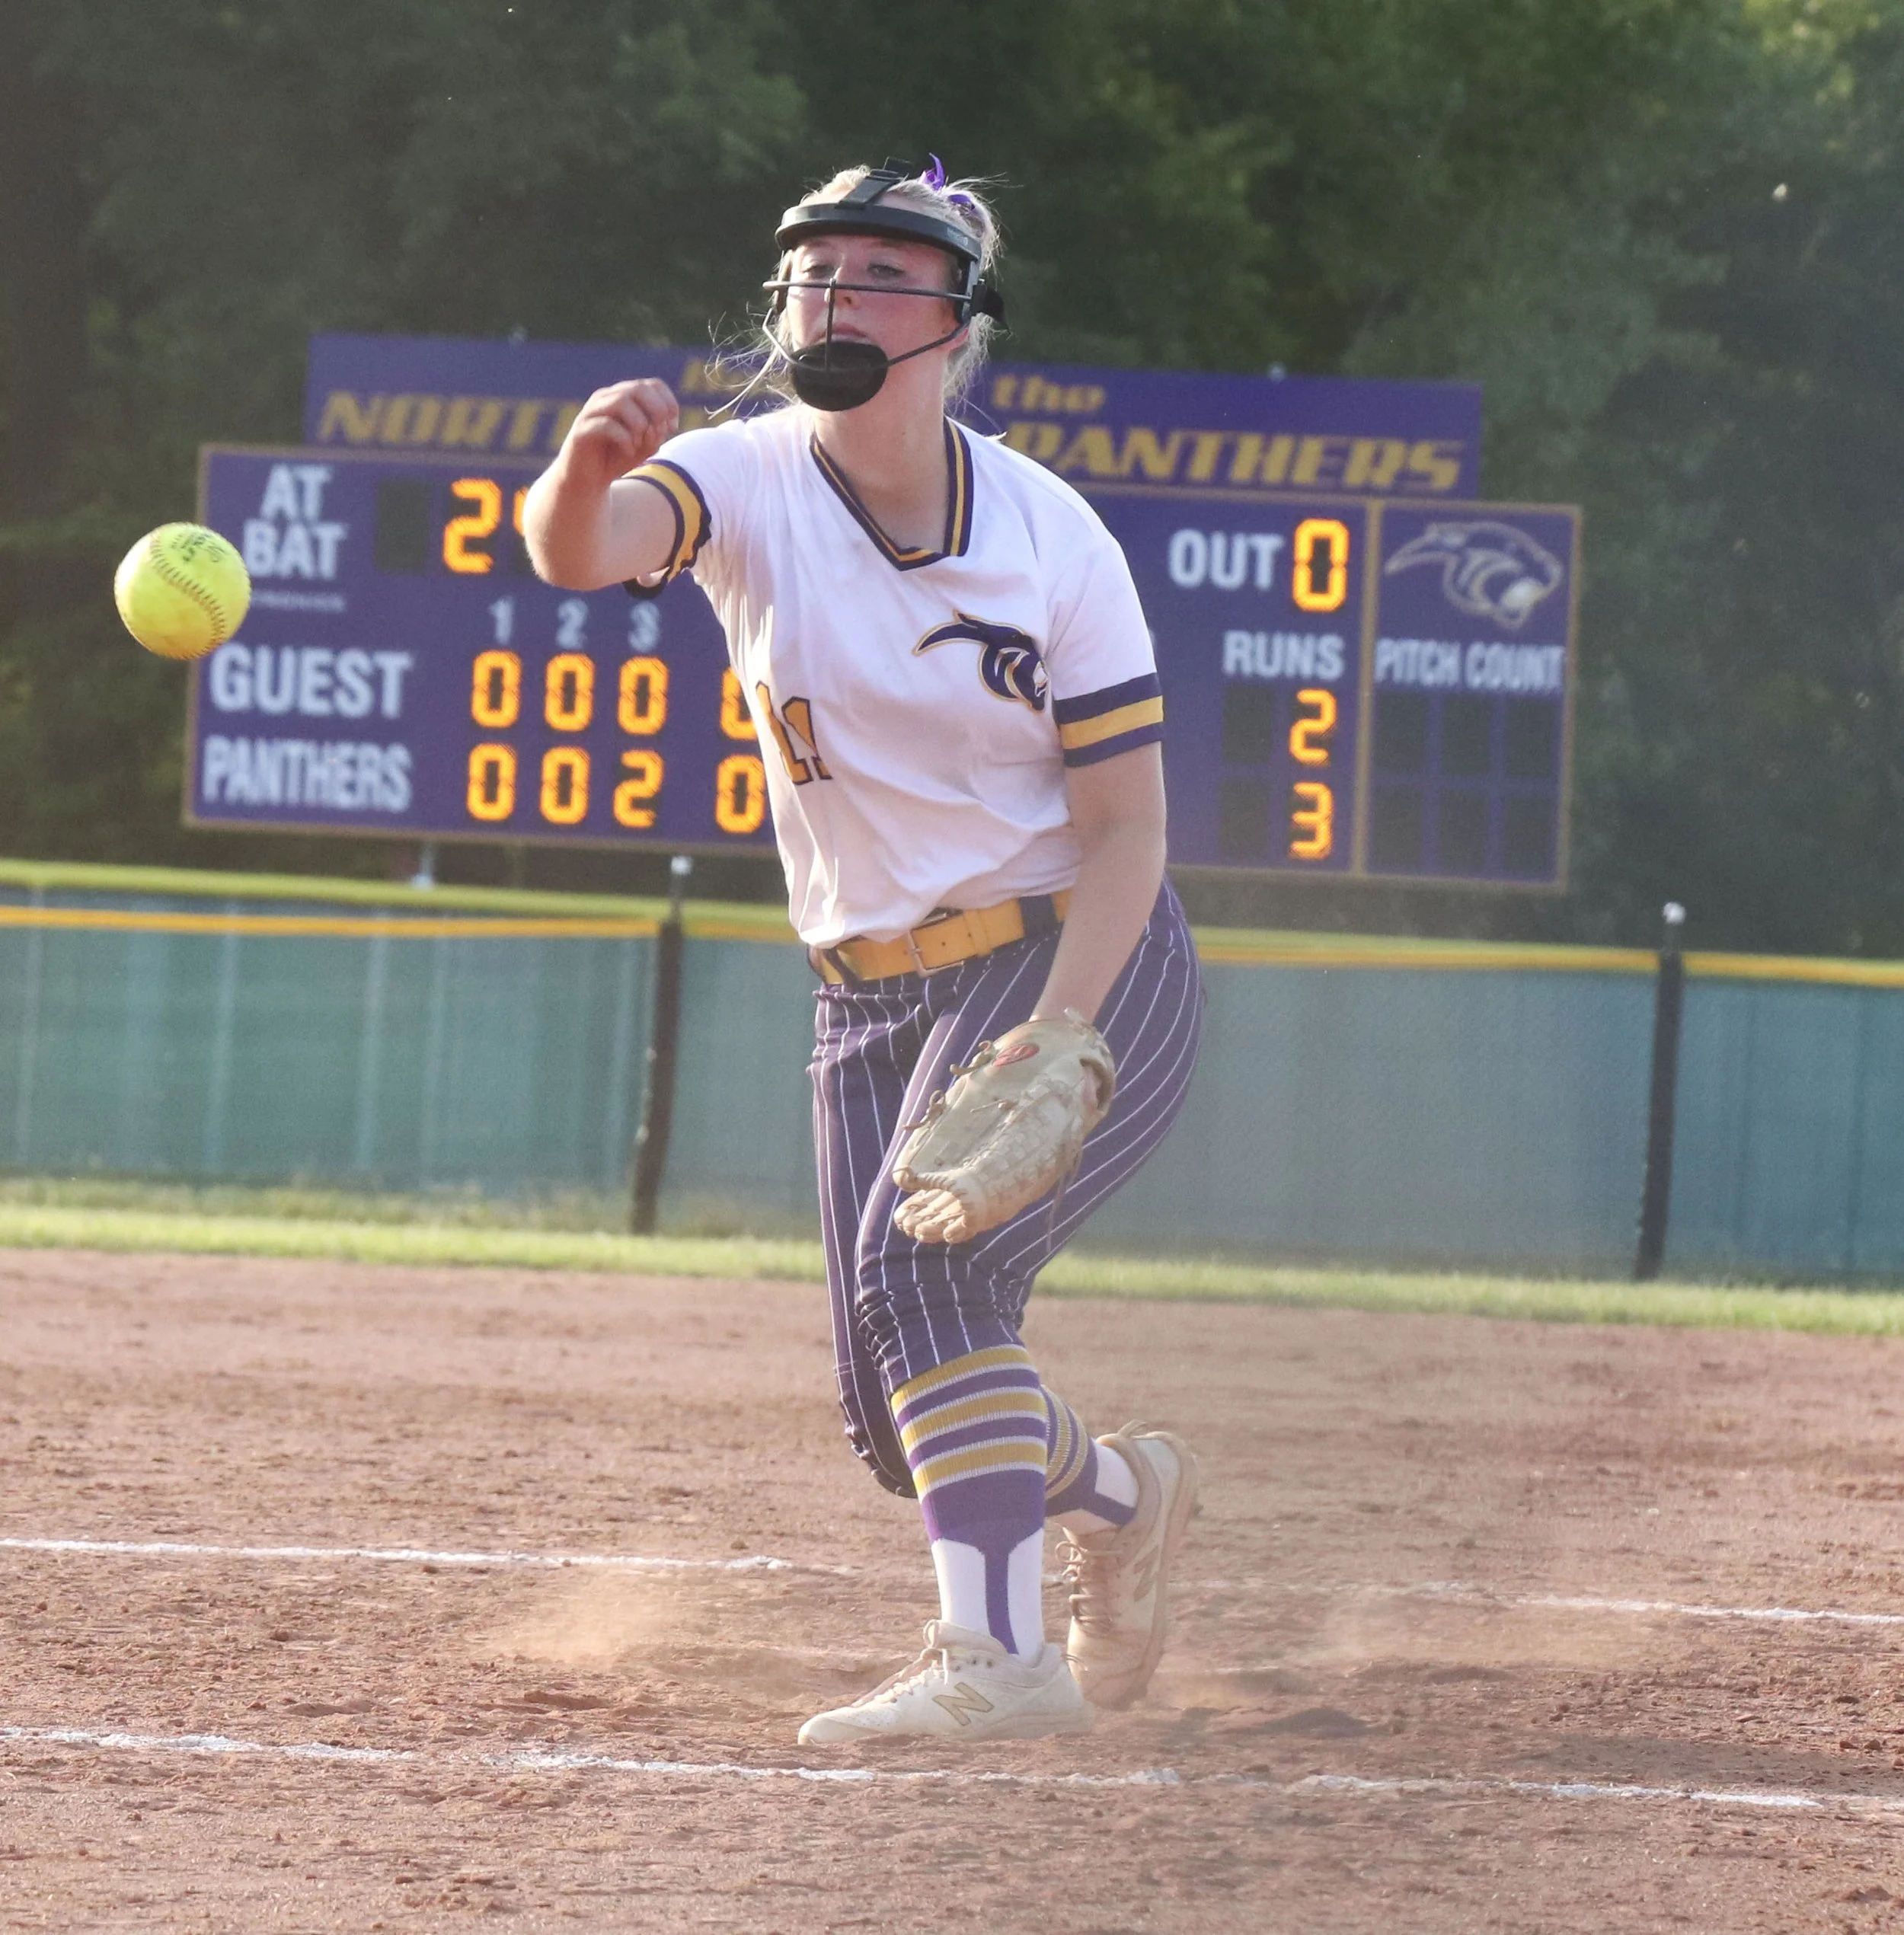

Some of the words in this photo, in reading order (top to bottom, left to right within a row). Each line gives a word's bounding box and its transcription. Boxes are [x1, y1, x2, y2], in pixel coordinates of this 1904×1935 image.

[992, 375, 1106, 413] the
[1001, 421, 1464, 490] PANTHERS
[259, 463, 332, 521] AT
[244, 519, 346, 579] BAT
[1168, 528, 1285, 590] OUT
[1292, 518, 1350, 612] 0
[488, 596, 516, 645] 1
[556, 599, 589, 649] 2
[628, 600, 662, 652] 3
[210, 643, 414, 717] GUEST
[1222, 630, 1345, 680] RUNS
[1374, 637, 1461, 687] PITCH
[1465, 640, 1564, 693] COUNT
[471, 650, 521, 728] 0
[544, 653, 595, 732] 0
[617, 656, 668, 735] 0
[1289, 688, 1337, 765] 2
[203, 736, 412, 812] PANTHERS
[467, 742, 517, 822] 0
[540, 746, 590, 825] 0
[613, 749, 663, 828] 2
[715, 754, 765, 834] 0
[1289, 782, 1334, 860] 3
[931, 1681, 995, 1726] N
